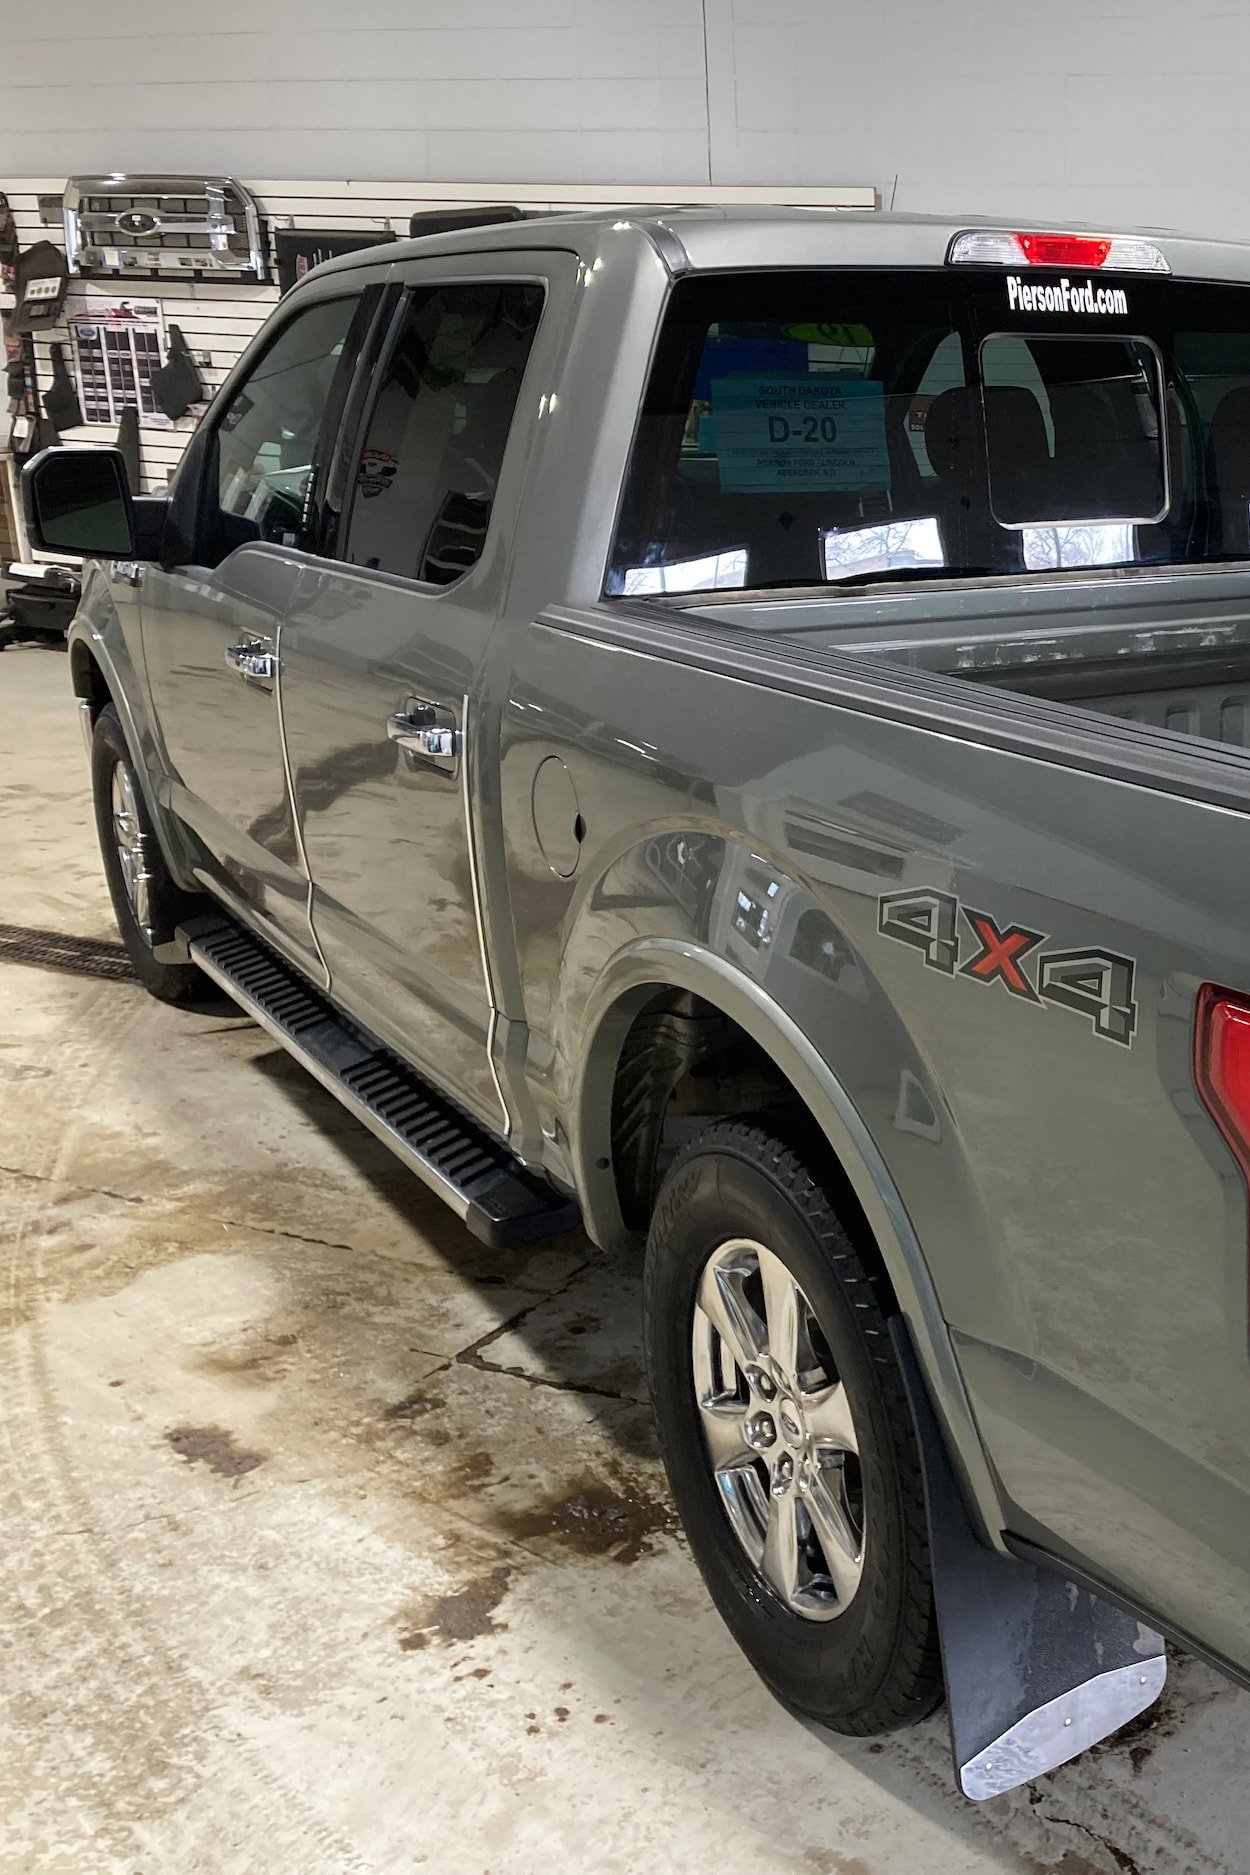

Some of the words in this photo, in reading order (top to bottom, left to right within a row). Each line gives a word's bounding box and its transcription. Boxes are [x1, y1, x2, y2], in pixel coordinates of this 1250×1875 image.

[1006, 275, 1129, 315] PiersonFord.com
[758, 385, 797, 397] SOUTH
[798, 385, 843, 397] DAKOTA
[754, 400, 801, 411] VEHICLE
[803, 399, 847, 411] DEALER
[767, 415, 838, 444] D-20
